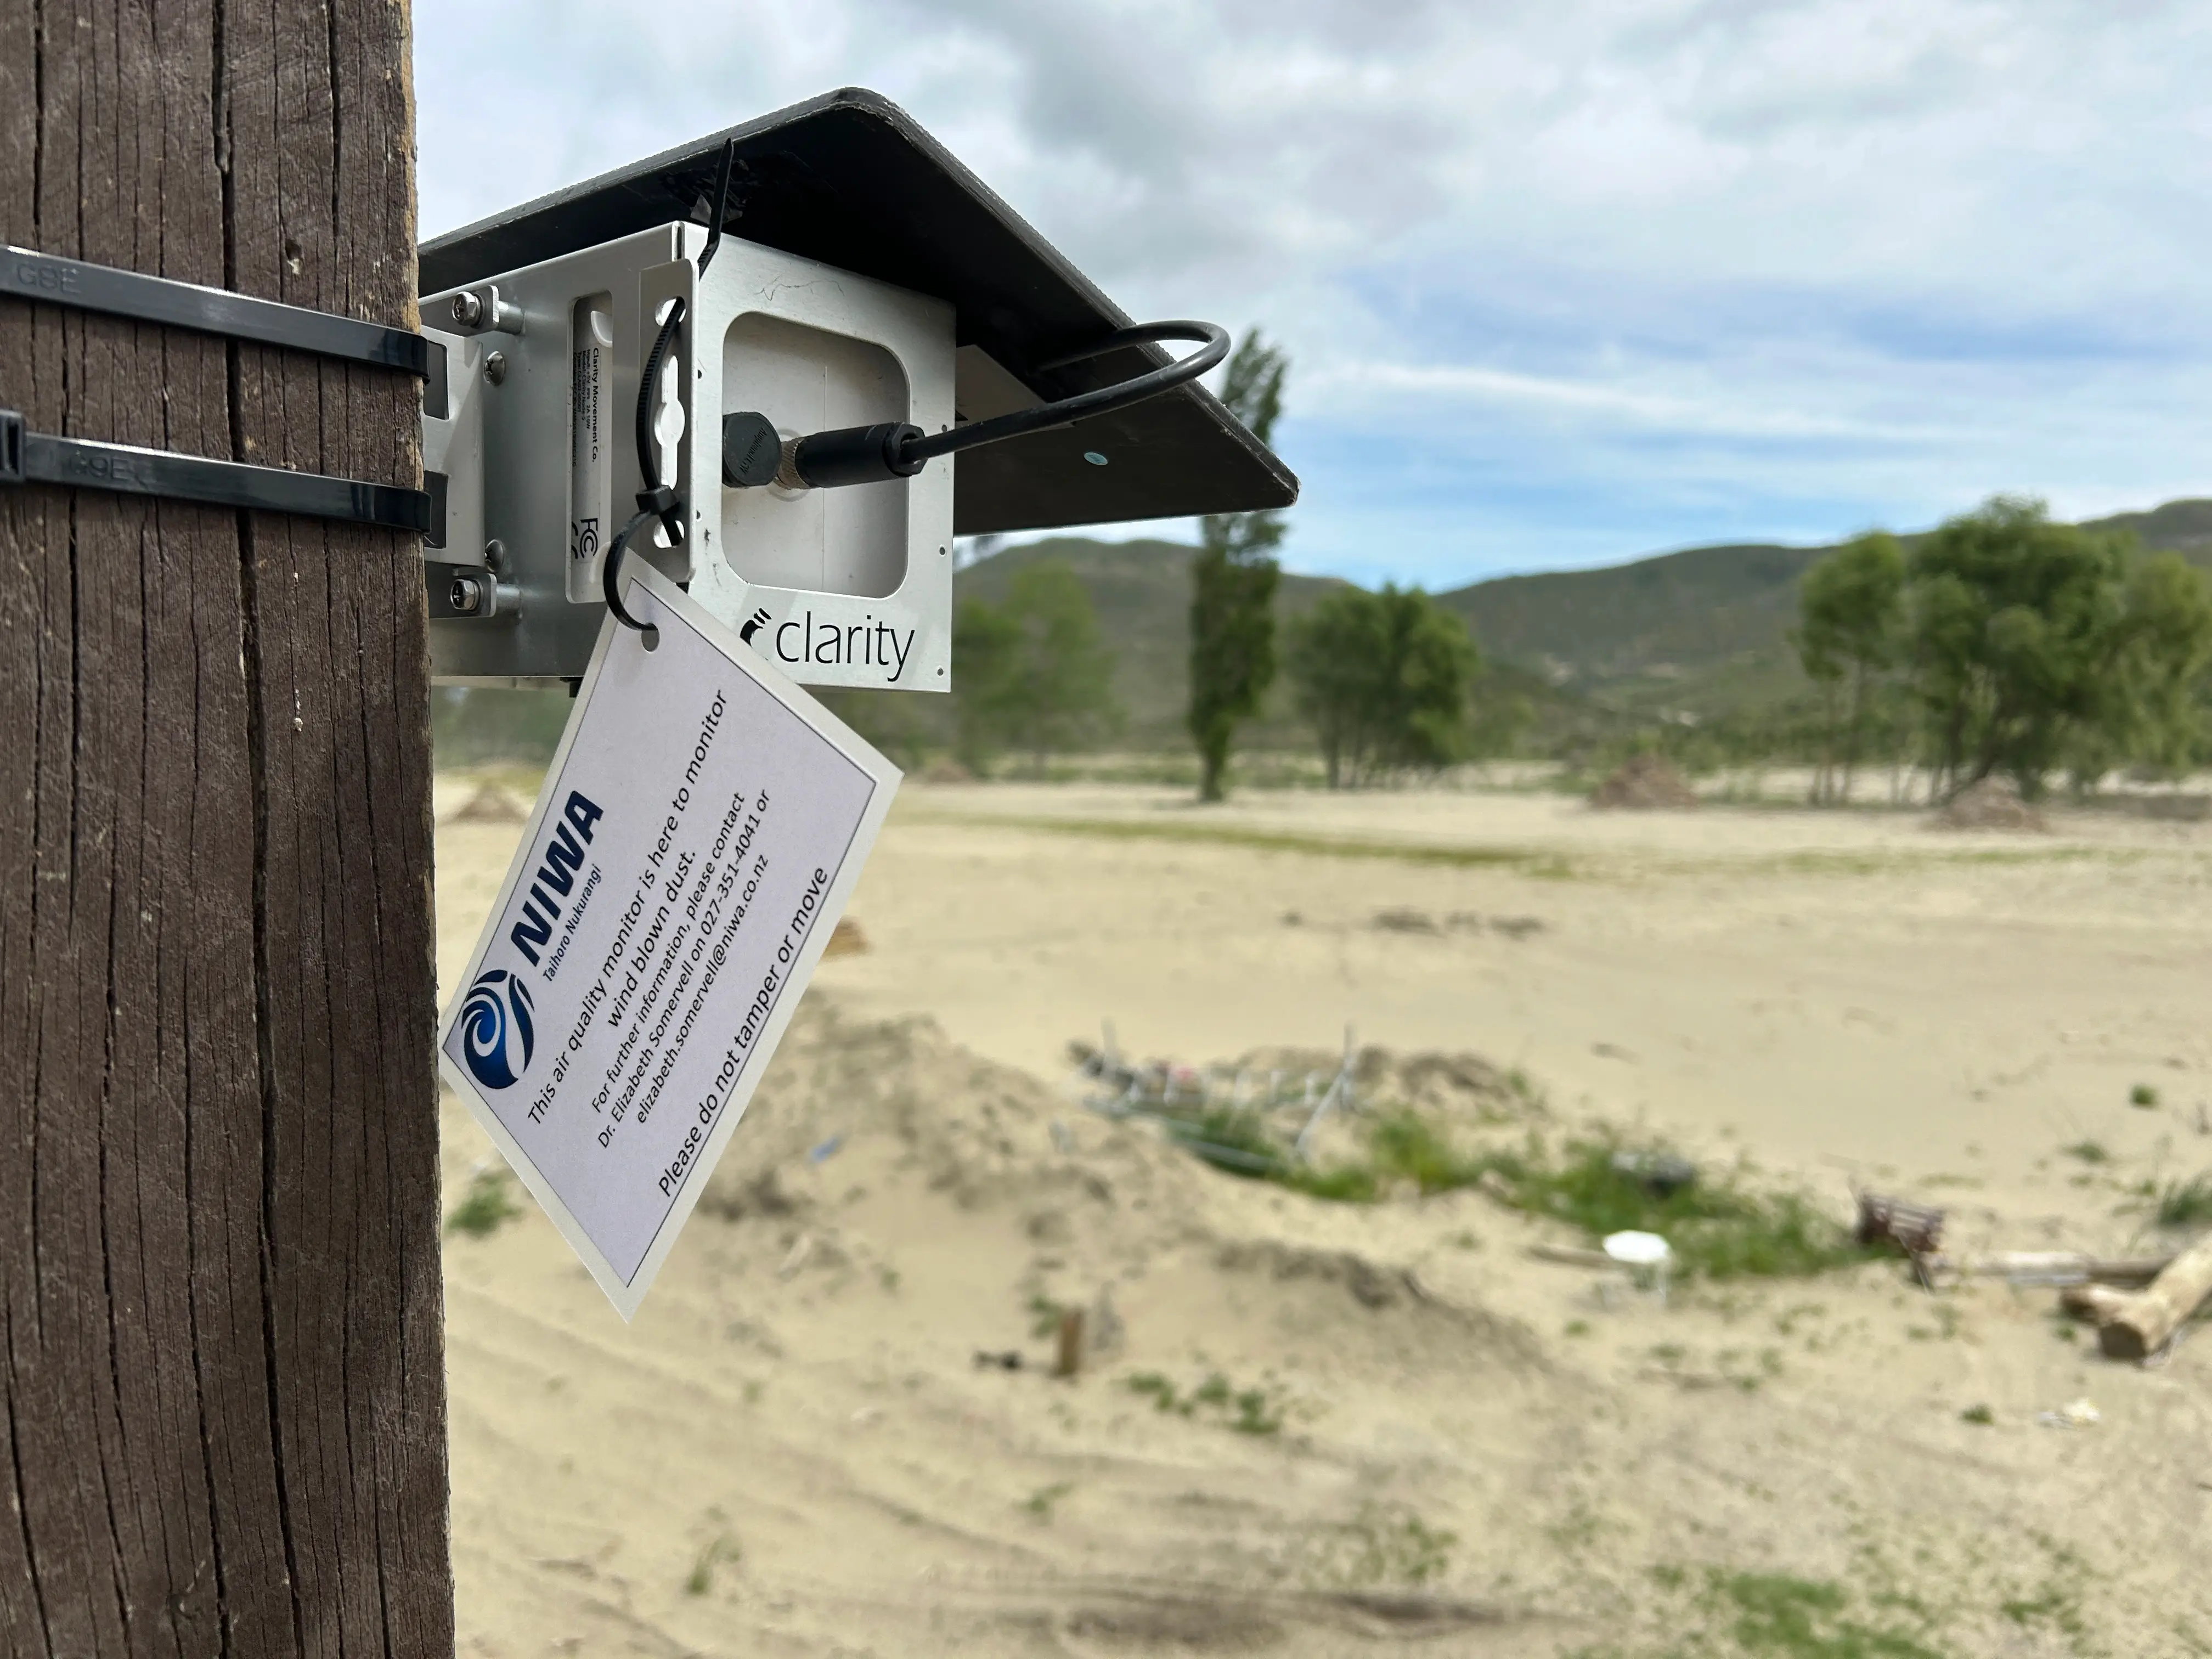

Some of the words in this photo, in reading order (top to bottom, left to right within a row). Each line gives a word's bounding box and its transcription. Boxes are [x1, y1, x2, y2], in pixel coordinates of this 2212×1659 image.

[776, 611, 915, 682] clarity
[510, 790, 604, 967] NIWA
[527, 1083, 556, 1124] This
[553, 1051, 569, 1082] air
[568, 978, 607, 1051] quality
[602, 889, 645, 978] monitor
[639, 869, 655, 890] is
[647, 816, 678, 868] here
[672, 787, 690, 812] to
[685, 689, 726, 785] monitor
[543, 935, 571, 981] Taihoro
[565, 866, 601, 935] Nukurangi
[591, 1083, 610, 1113] For
[607, 1023, 640, 1084] further
[637, 924, 691, 1023] information,
[686, 862, 715, 921] please
[712, 793, 745, 860] contact
[597, 1125, 616, 1148] Dr.
[611, 1048, 654, 1122] Elizabeth
[649, 960, 694, 1047] Somervell
[691, 938, 706, 962] on
[701, 814, 760, 935] 027-351-4041
[757, 789, 769, 812] or
[608, 970, 639, 1027] wind
[630, 906, 670, 974] blown
[665, 851, 696, 902] dust.
[637, 854, 769, 1124] elizabeth.somervell@niwa.co.nz
[659, 1126, 702, 1198] Please
[698, 1094, 718, 1125] do
[715, 1049, 740, 1093] not
[733, 964, 781, 1050] tamper
[778, 934, 794, 963] or
[791, 868, 827, 934] move
